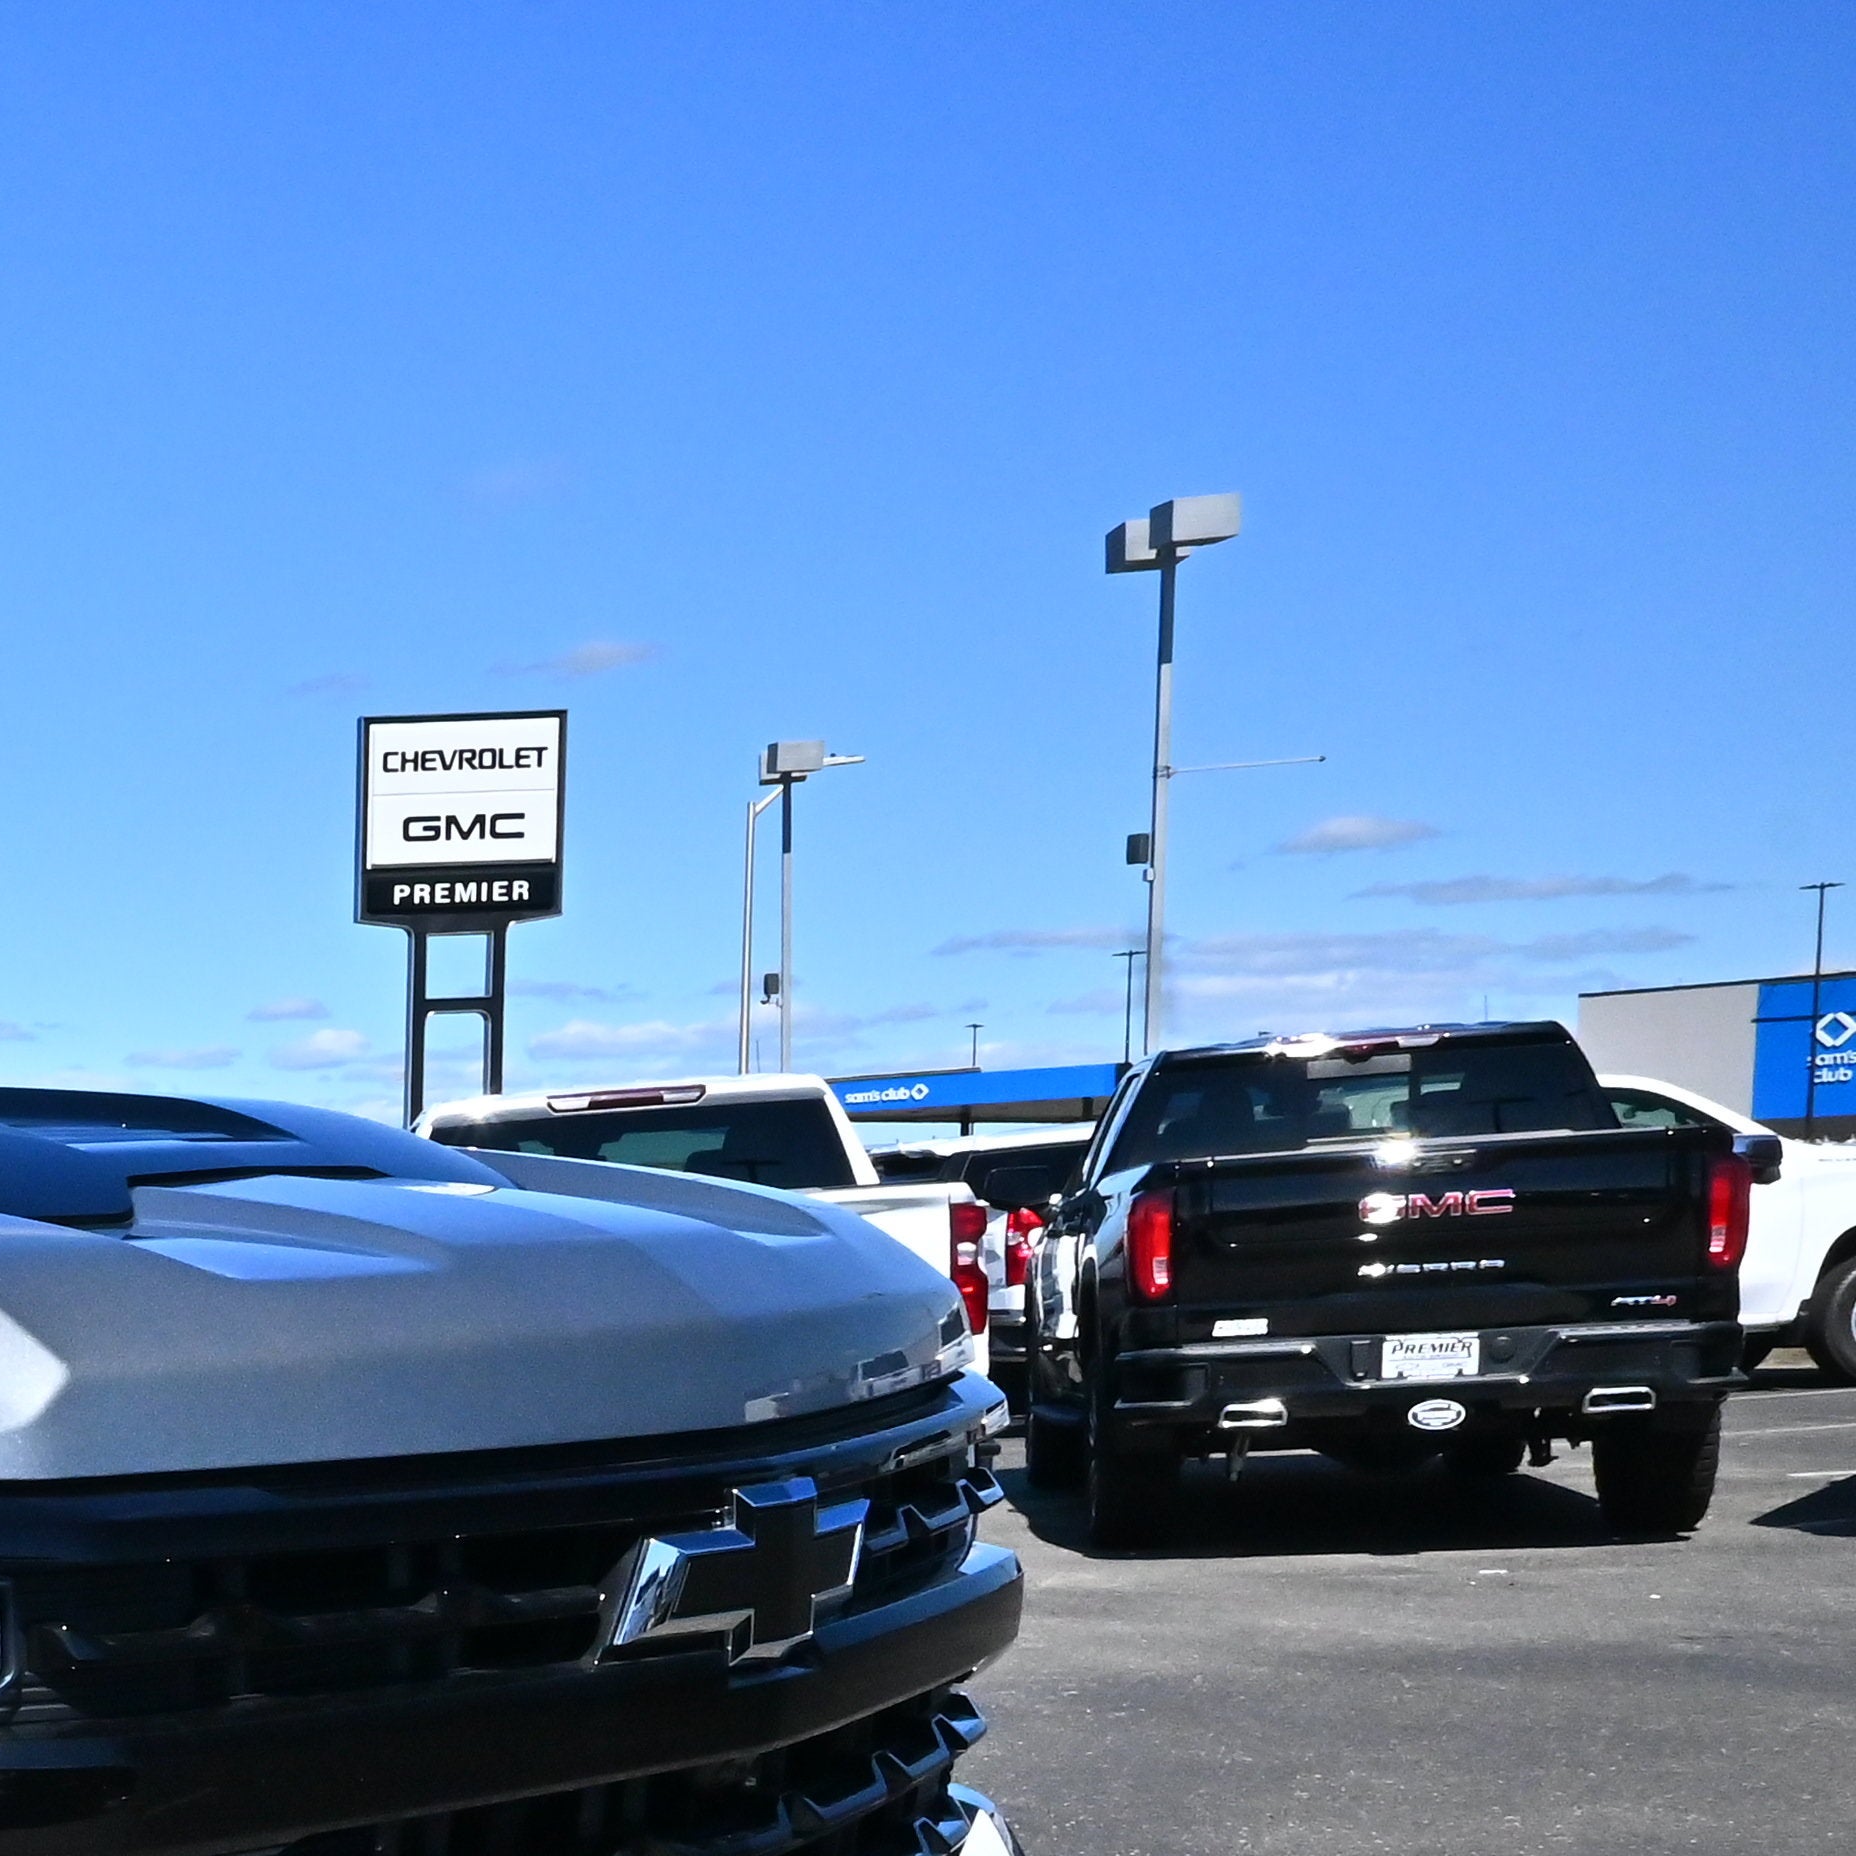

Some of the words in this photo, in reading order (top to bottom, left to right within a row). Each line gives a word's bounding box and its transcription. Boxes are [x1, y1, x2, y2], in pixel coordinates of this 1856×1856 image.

[382, 746, 549, 773] CHEVROLET
[402, 812, 526, 842] GMC
[392, 880, 531, 906] PREMIER
[1807, 1050, 1856, 1066] am's
[1358, 1189, 1517, 1224] GMC
[1391, 1340, 1473, 1358] PREMIER
